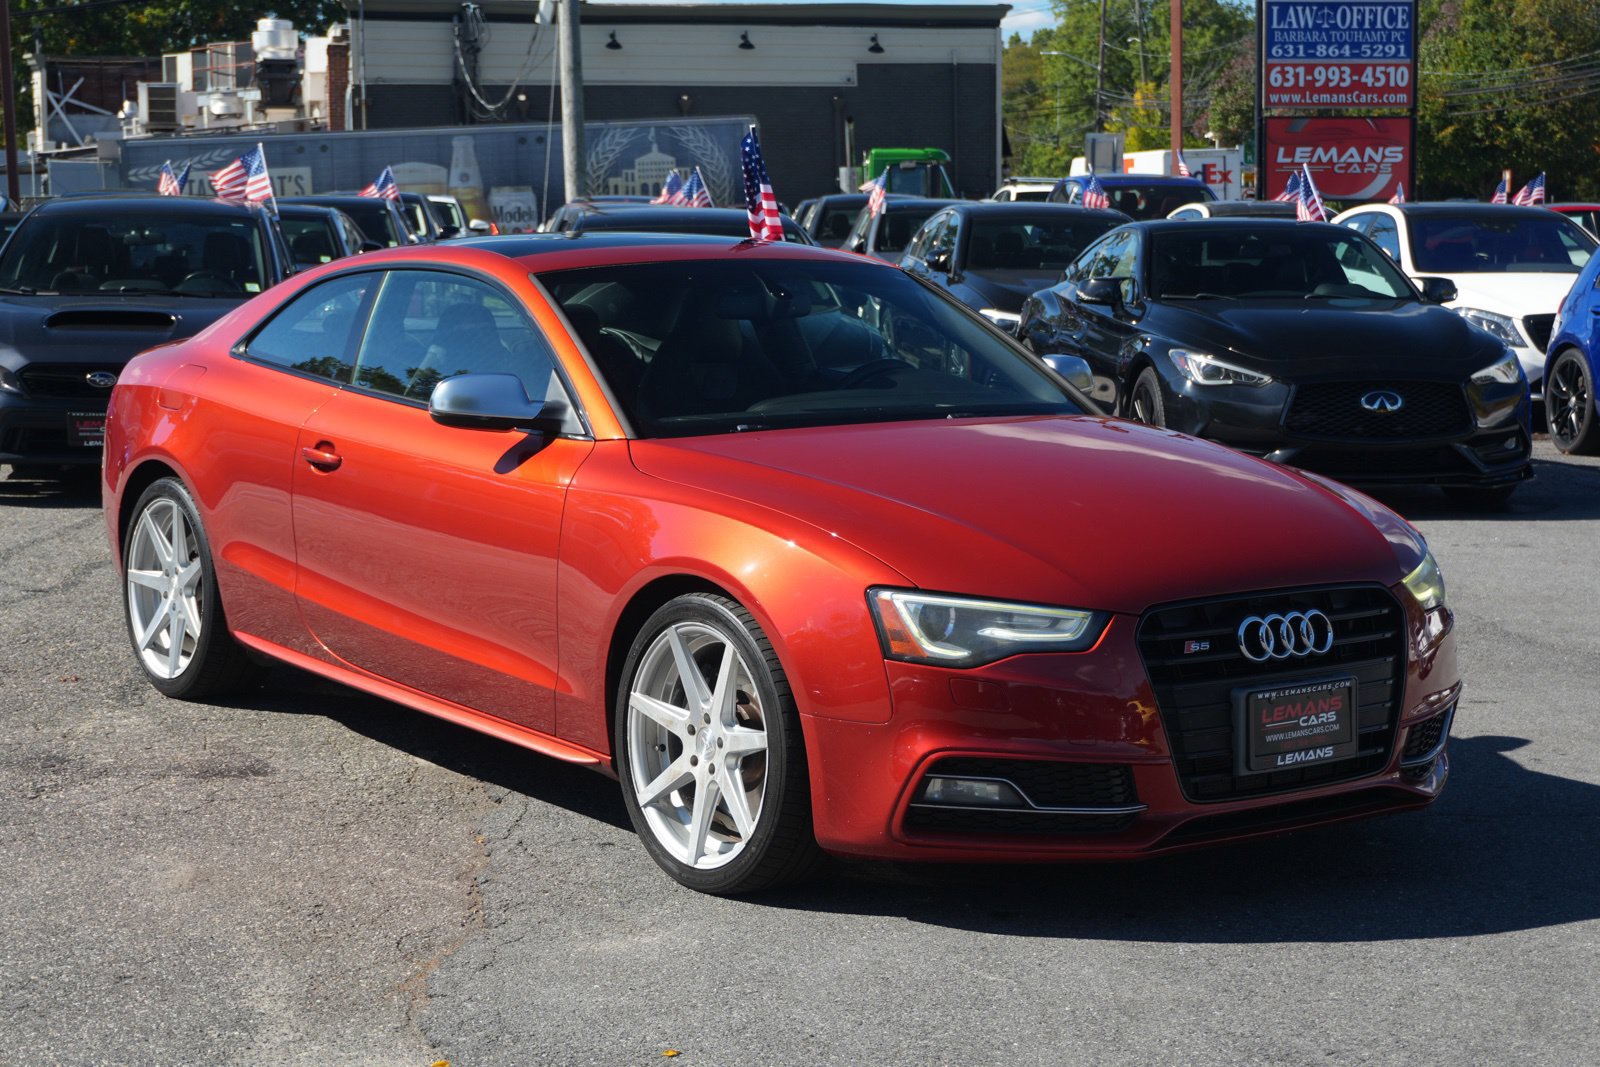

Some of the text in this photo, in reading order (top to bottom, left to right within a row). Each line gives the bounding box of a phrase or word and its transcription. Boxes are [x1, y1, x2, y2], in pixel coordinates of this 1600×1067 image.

[1271, 5, 1409, 29] LAW OFFICE
[1274, 31, 1405, 42] BARBARA TOUHAMY PC
[1271, 44, 1407, 58] 631-864-5291
[1269, 66, 1409, 87] 631-993-4510
[1269, 91, 1408, 104] www.LemansCars.com
[1276, 146, 1404, 164] LEMANS
[1333, 163, 1392, 174] CARS
[1190, 642, 1210, 651] S5
[1257, 681, 1351, 699] WWW.LEMANSCARS.COM
[1262, 695, 1344, 723] LEMANS
[1299, 711, 1337, 727] CARS
[1265, 724, 1340, 742] WWW.LEMANSCARS.COM
[1276, 746, 1334, 765] LEMANS
